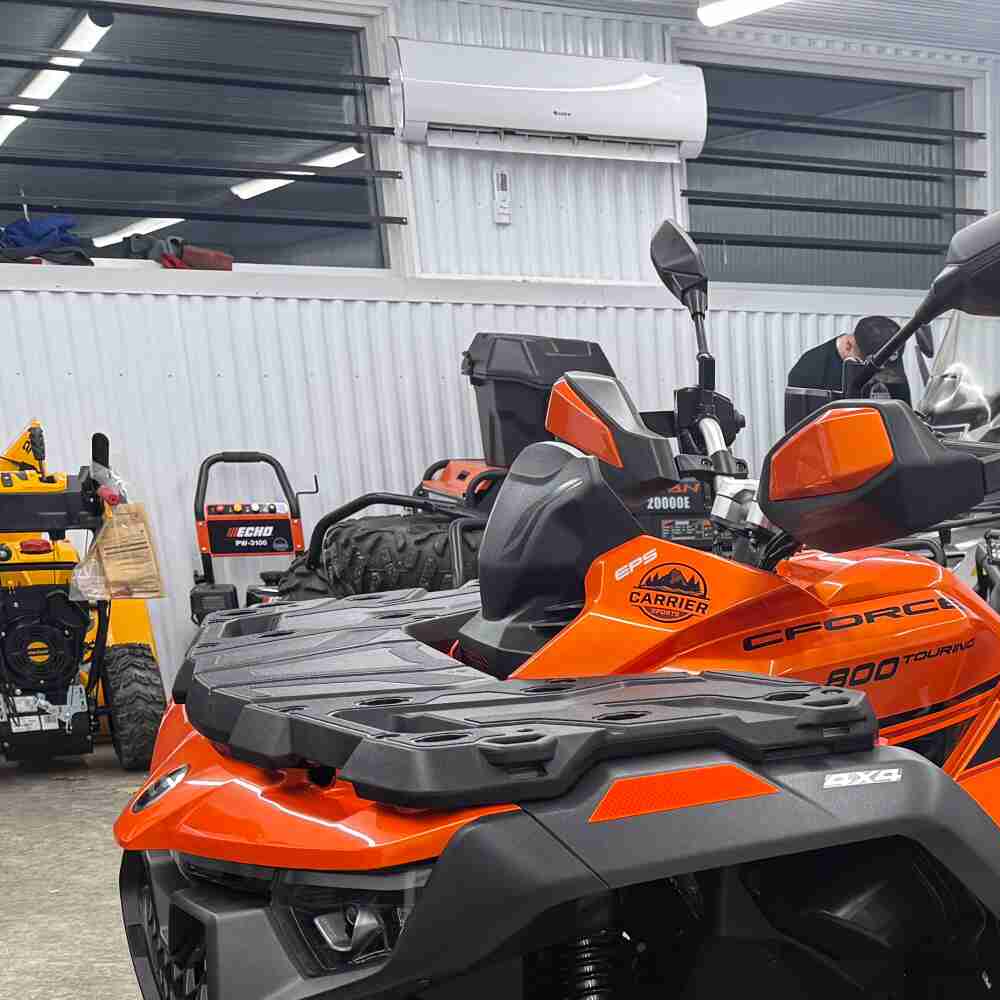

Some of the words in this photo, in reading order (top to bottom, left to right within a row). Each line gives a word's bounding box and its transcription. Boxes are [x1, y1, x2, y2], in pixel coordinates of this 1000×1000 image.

[236, 526, 275, 538] ECHO
[614, 548, 658, 582] EPS
[629, 591, 710, 615] CARRIER
